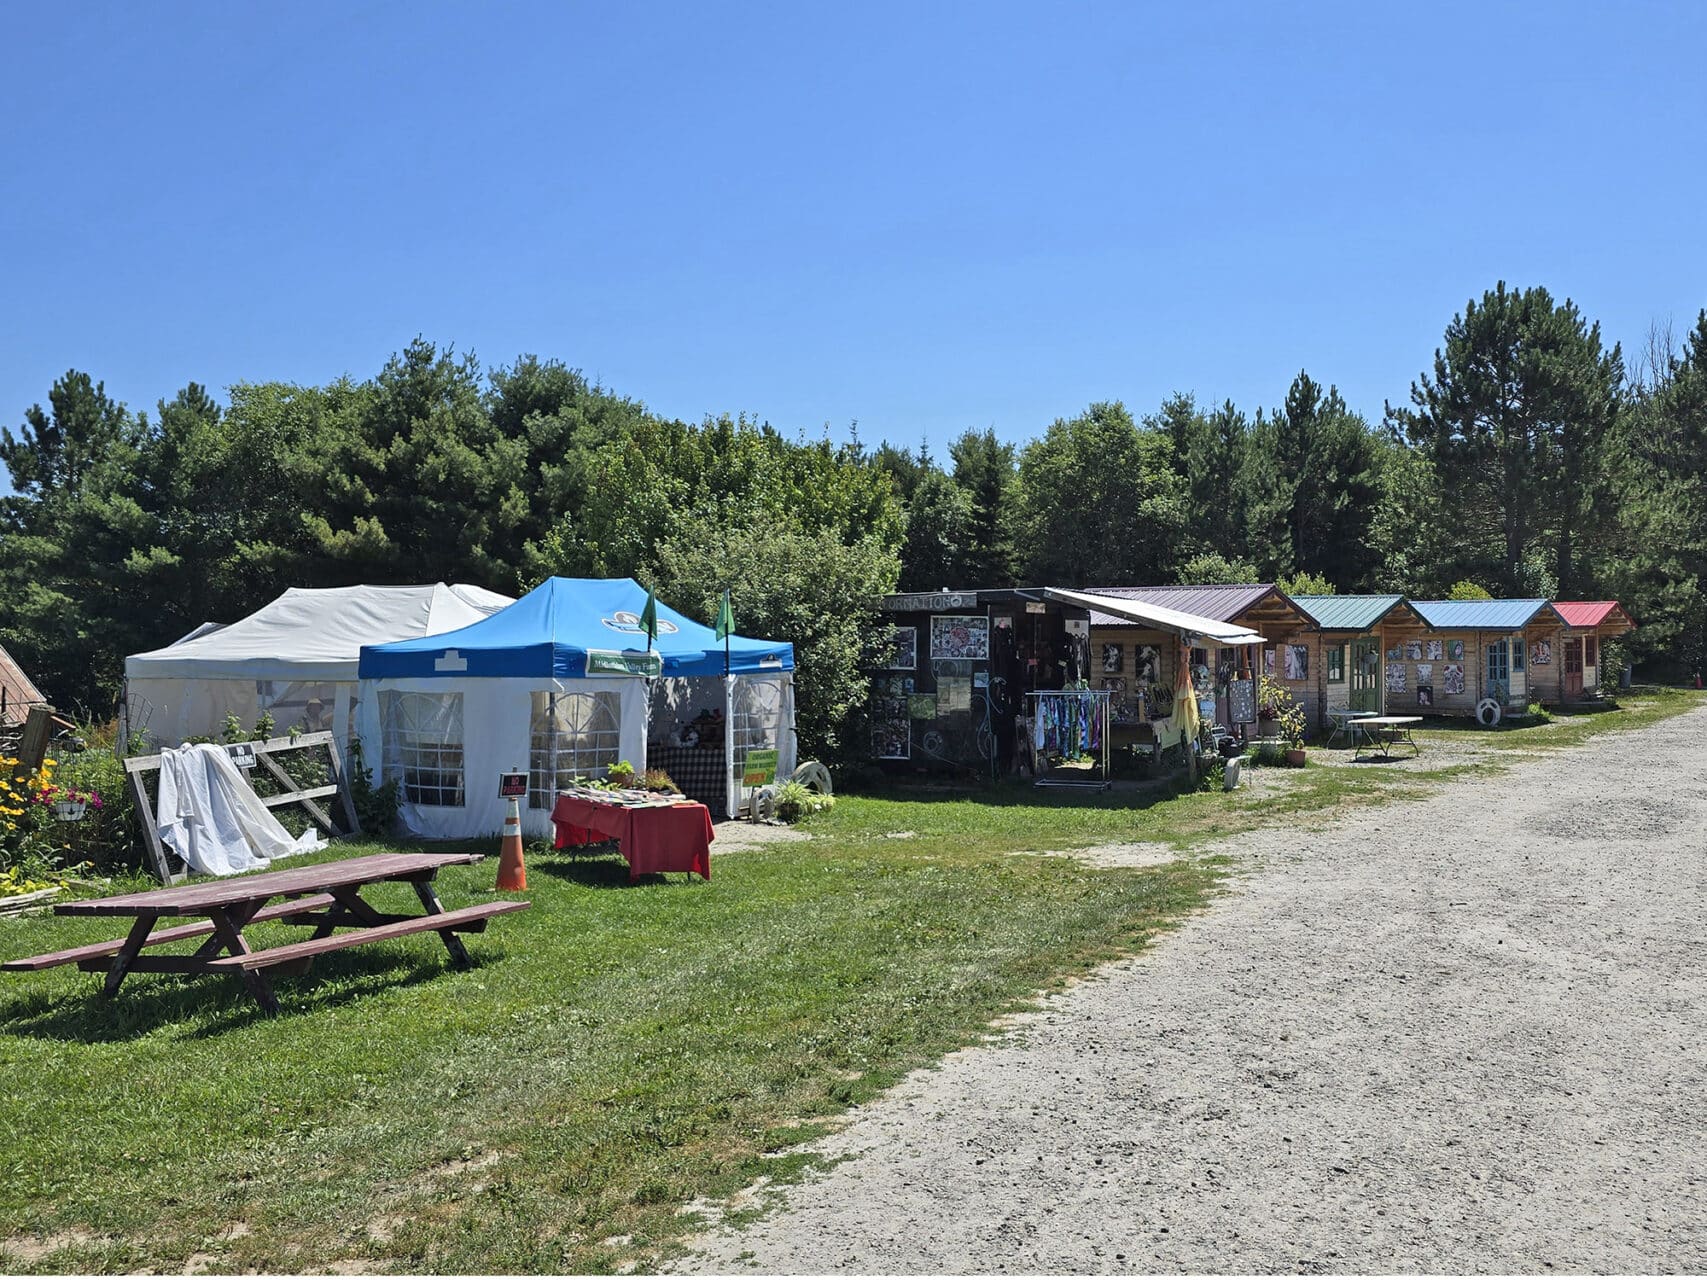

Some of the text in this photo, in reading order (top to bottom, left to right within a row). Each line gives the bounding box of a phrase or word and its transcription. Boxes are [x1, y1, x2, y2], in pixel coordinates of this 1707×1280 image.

[236, 746, 245, 755] NO
[231, 754, 254, 764] PARKING
[511, 776, 520, 785] NO
[744, 773, 765, 784] OPEN
